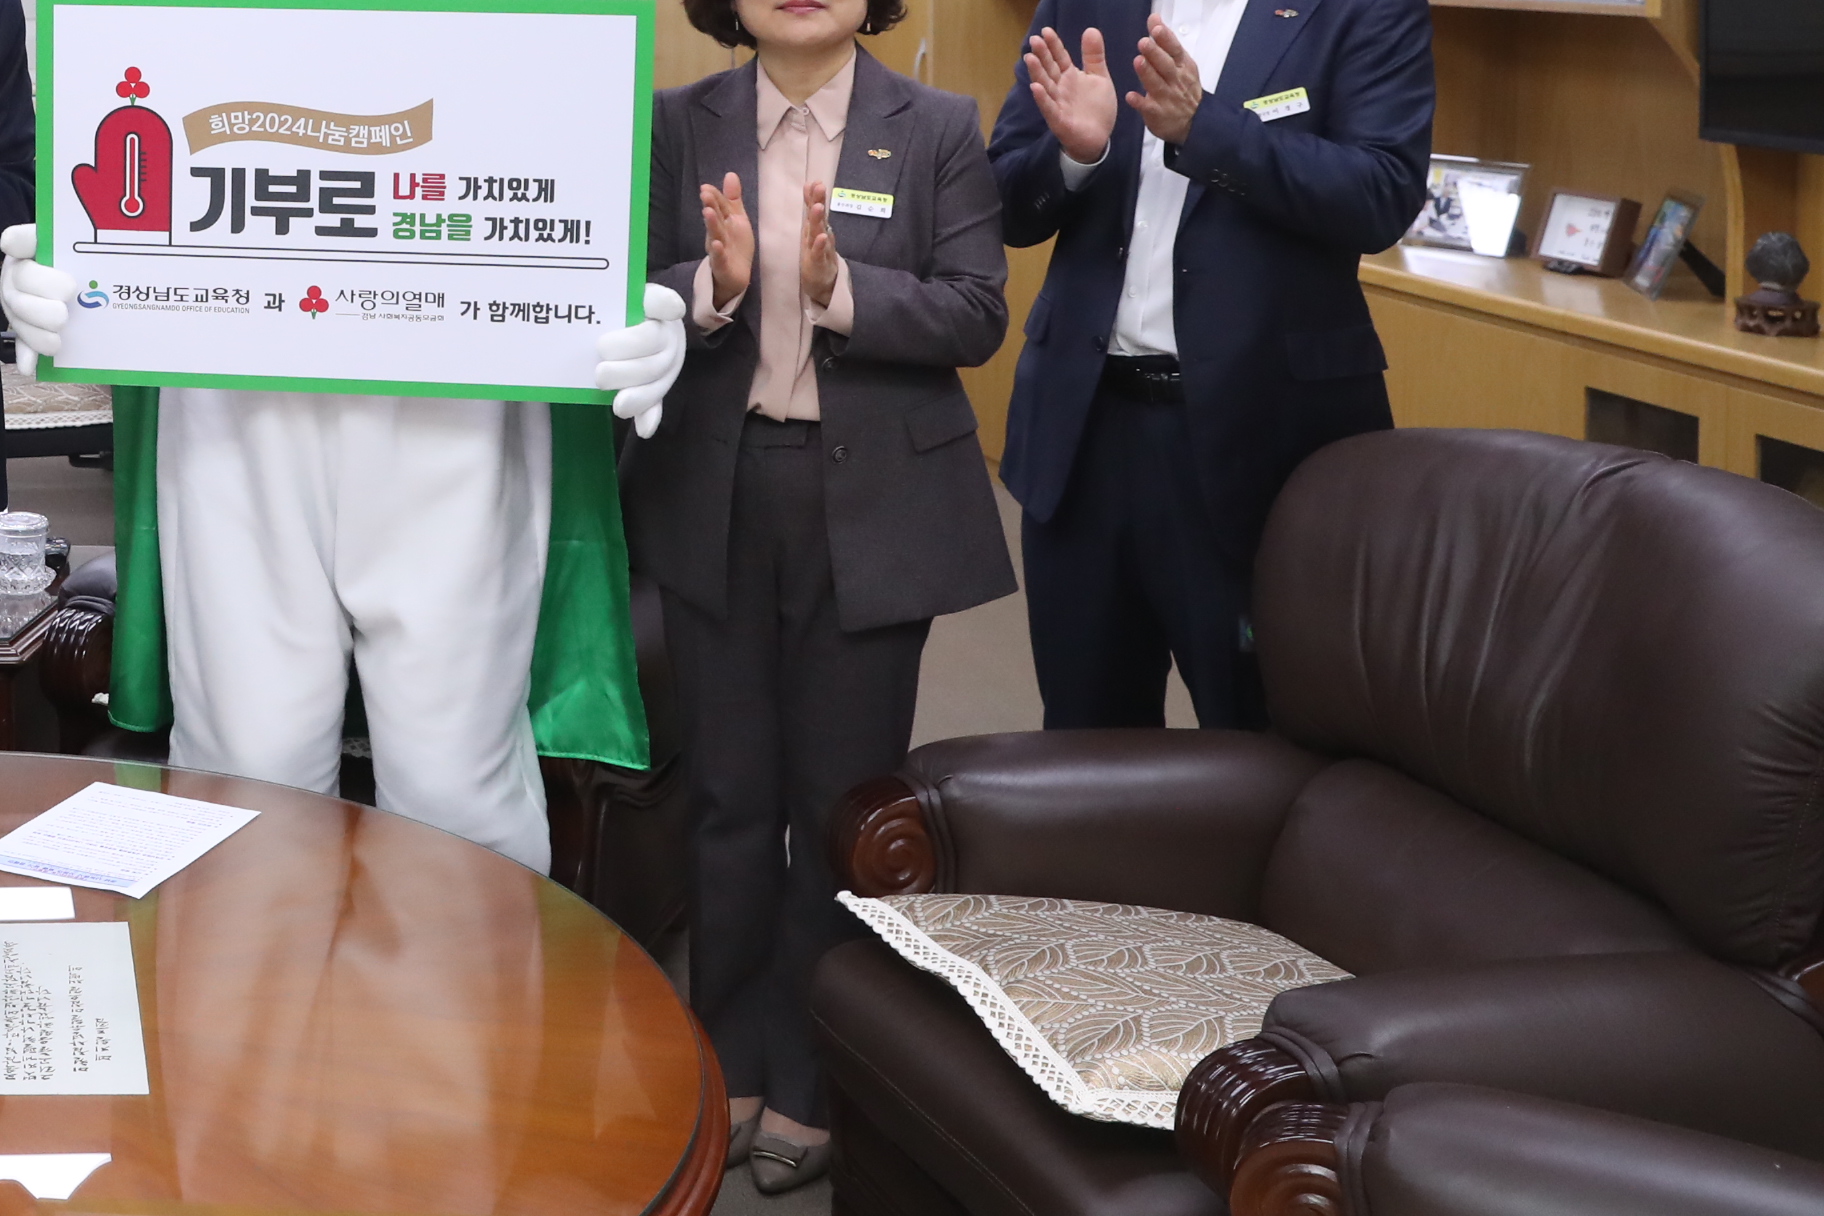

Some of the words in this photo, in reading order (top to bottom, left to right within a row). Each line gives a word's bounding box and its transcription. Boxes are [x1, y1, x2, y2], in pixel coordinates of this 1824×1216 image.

[209, 111, 414, 148] 희망2024나눔캠페인
[190, 167, 378, 238] 기부로
[393, 172, 447, 201] 나를
[458, 176, 555, 203] 가치있게
[392, 212, 473, 241] 경남을
[484, 217, 591, 245] 가치있게!
[112, 284, 250, 305] 경상남도교육청
[264, 293, 285, 312] 과
[335, 290, 444, 311] 사랑의열매
[460, 301, 480, 320] 가
[488, 300, 600, 324] 함께합니다.
[112, 302, 181, 312] GYEONGSANGNAMDO
[182, 304, 202, 313] OFFICE
[204, 305, 213, 313] OF
[213, 305, 250, 314] EDUCATION
